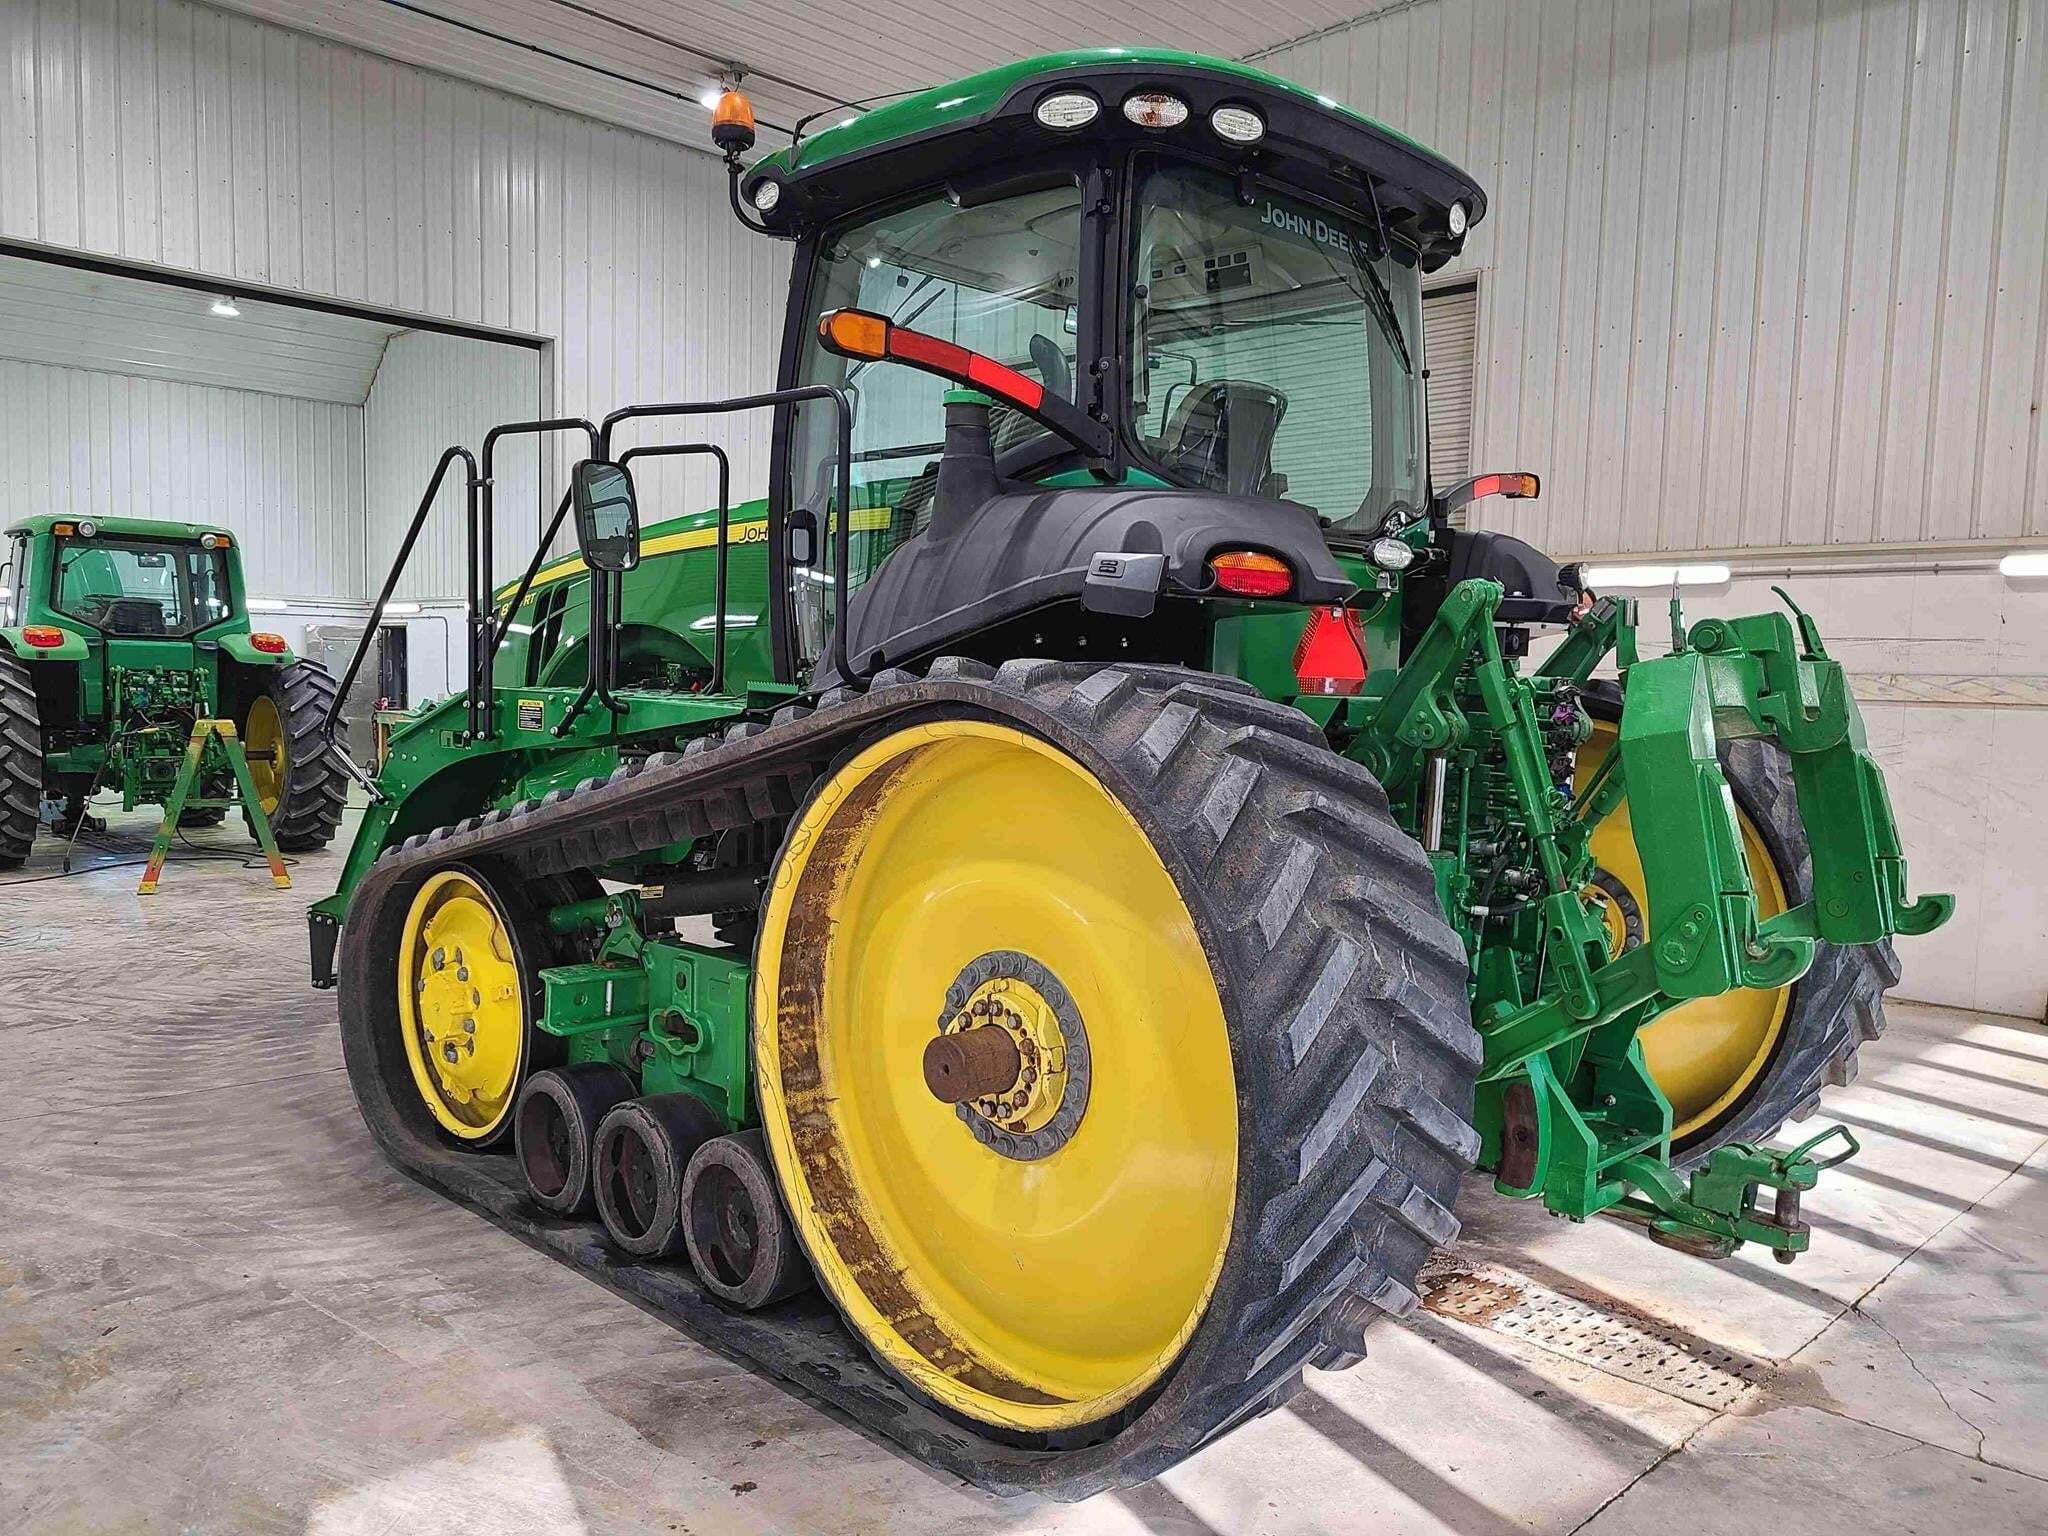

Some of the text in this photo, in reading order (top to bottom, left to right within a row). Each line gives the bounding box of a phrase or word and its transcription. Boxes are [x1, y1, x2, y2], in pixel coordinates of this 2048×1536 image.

[1261, 202, 1368, 254] JOHN DEEE
[739, 525, 769, 542] JOH
